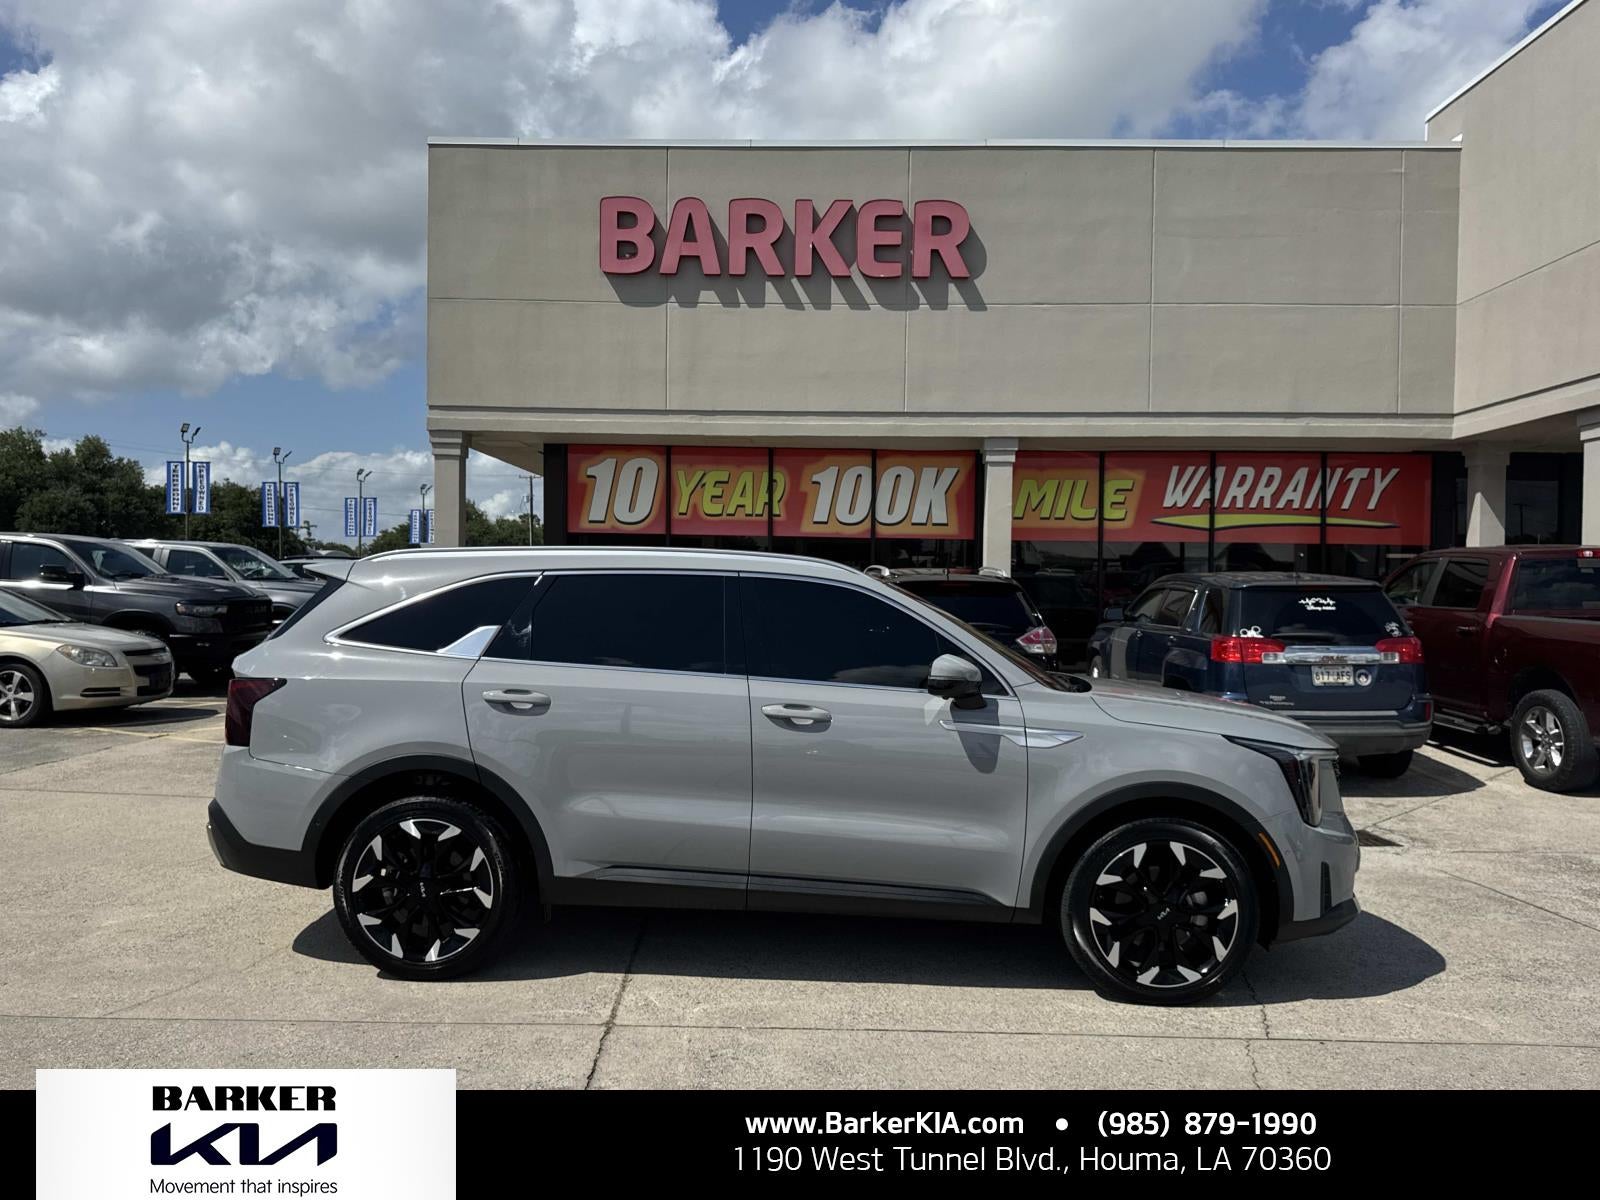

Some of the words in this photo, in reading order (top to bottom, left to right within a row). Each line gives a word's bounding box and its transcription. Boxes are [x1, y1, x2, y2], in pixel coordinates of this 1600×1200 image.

[600, 196, 970, 279] BARKER
[586, 458, 659, 525] 10
[677, 469, 786, 517] YEAR
[811, 465, 960, 526] 100K
[1013, 479, 1135, 521] MILE
[1162, 465, 1400, 511] WARRANTY
